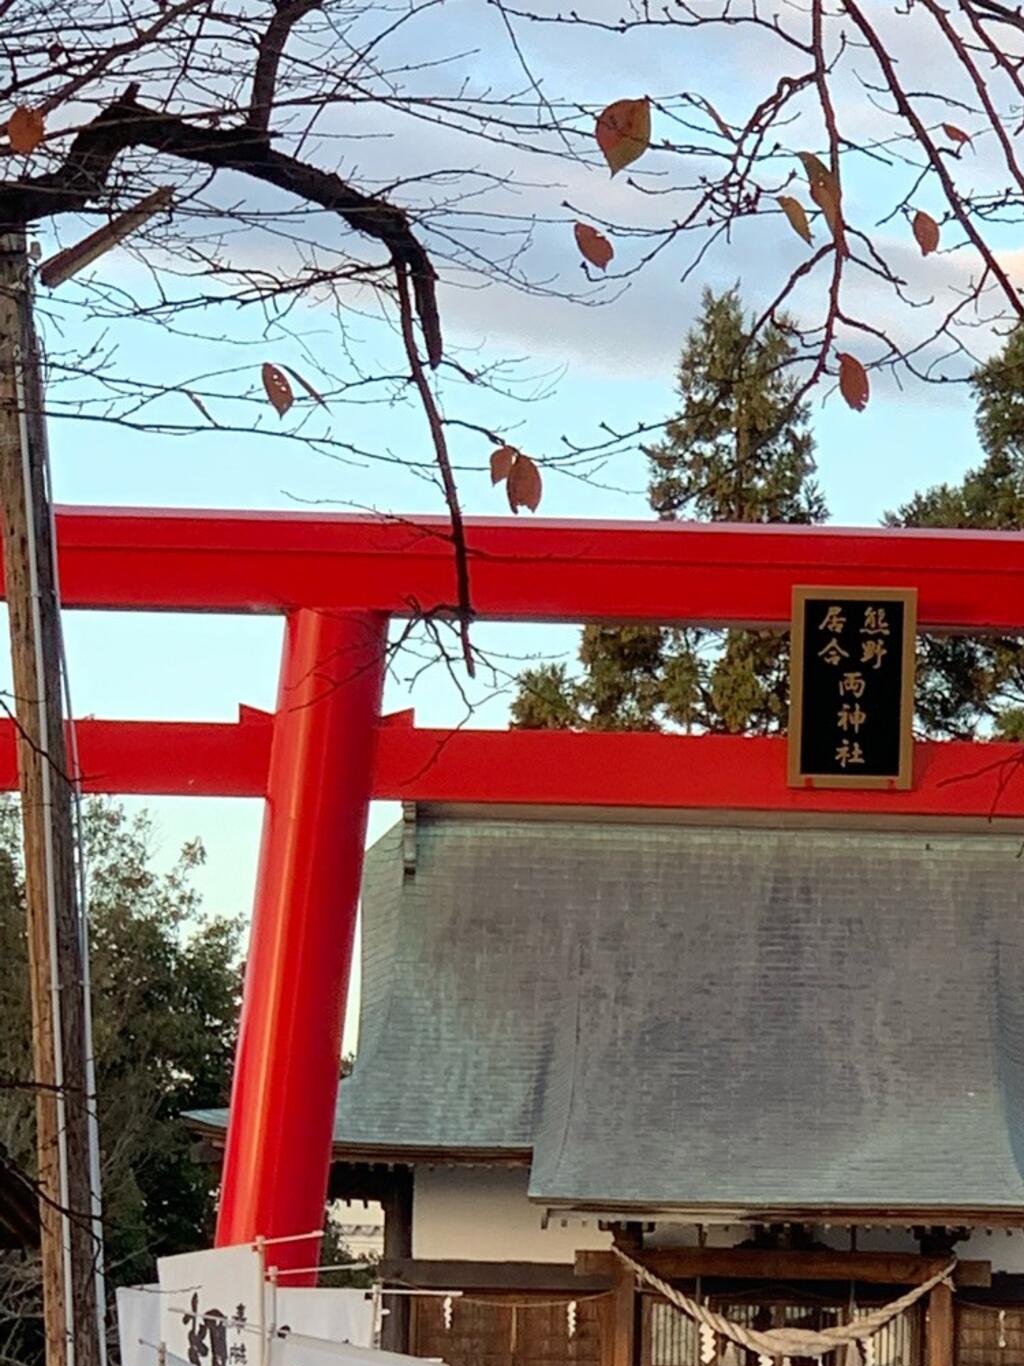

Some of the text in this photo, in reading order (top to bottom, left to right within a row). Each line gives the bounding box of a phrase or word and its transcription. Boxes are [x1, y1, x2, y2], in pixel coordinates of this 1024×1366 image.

[818, 605, 850, 666] 居合
[860, 606, 890, 669] 熊野
[834, 671, 867, 768] 両神社
